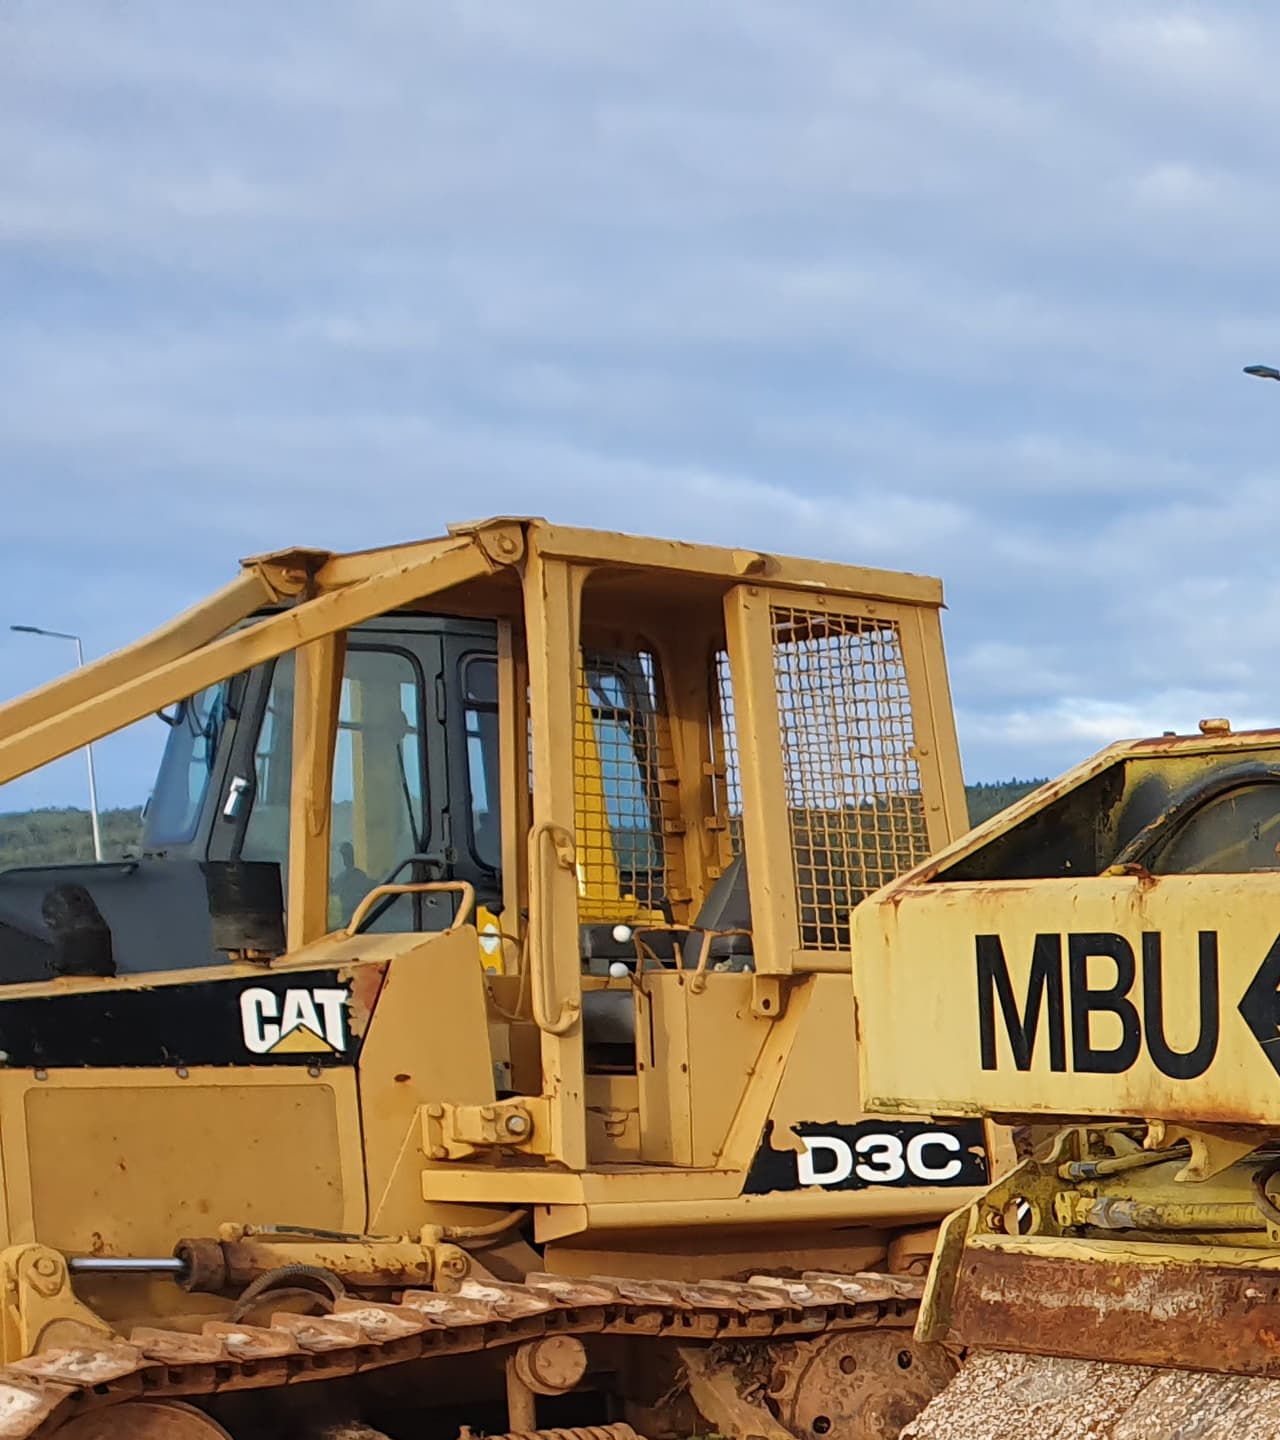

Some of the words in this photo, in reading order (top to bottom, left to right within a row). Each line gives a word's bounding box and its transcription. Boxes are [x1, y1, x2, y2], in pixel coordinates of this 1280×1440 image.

[240, 987, 349, 1054] CAT
[975, 930, 1220, 1080] MBU
[797, 1132, 963, 1185] D3C
